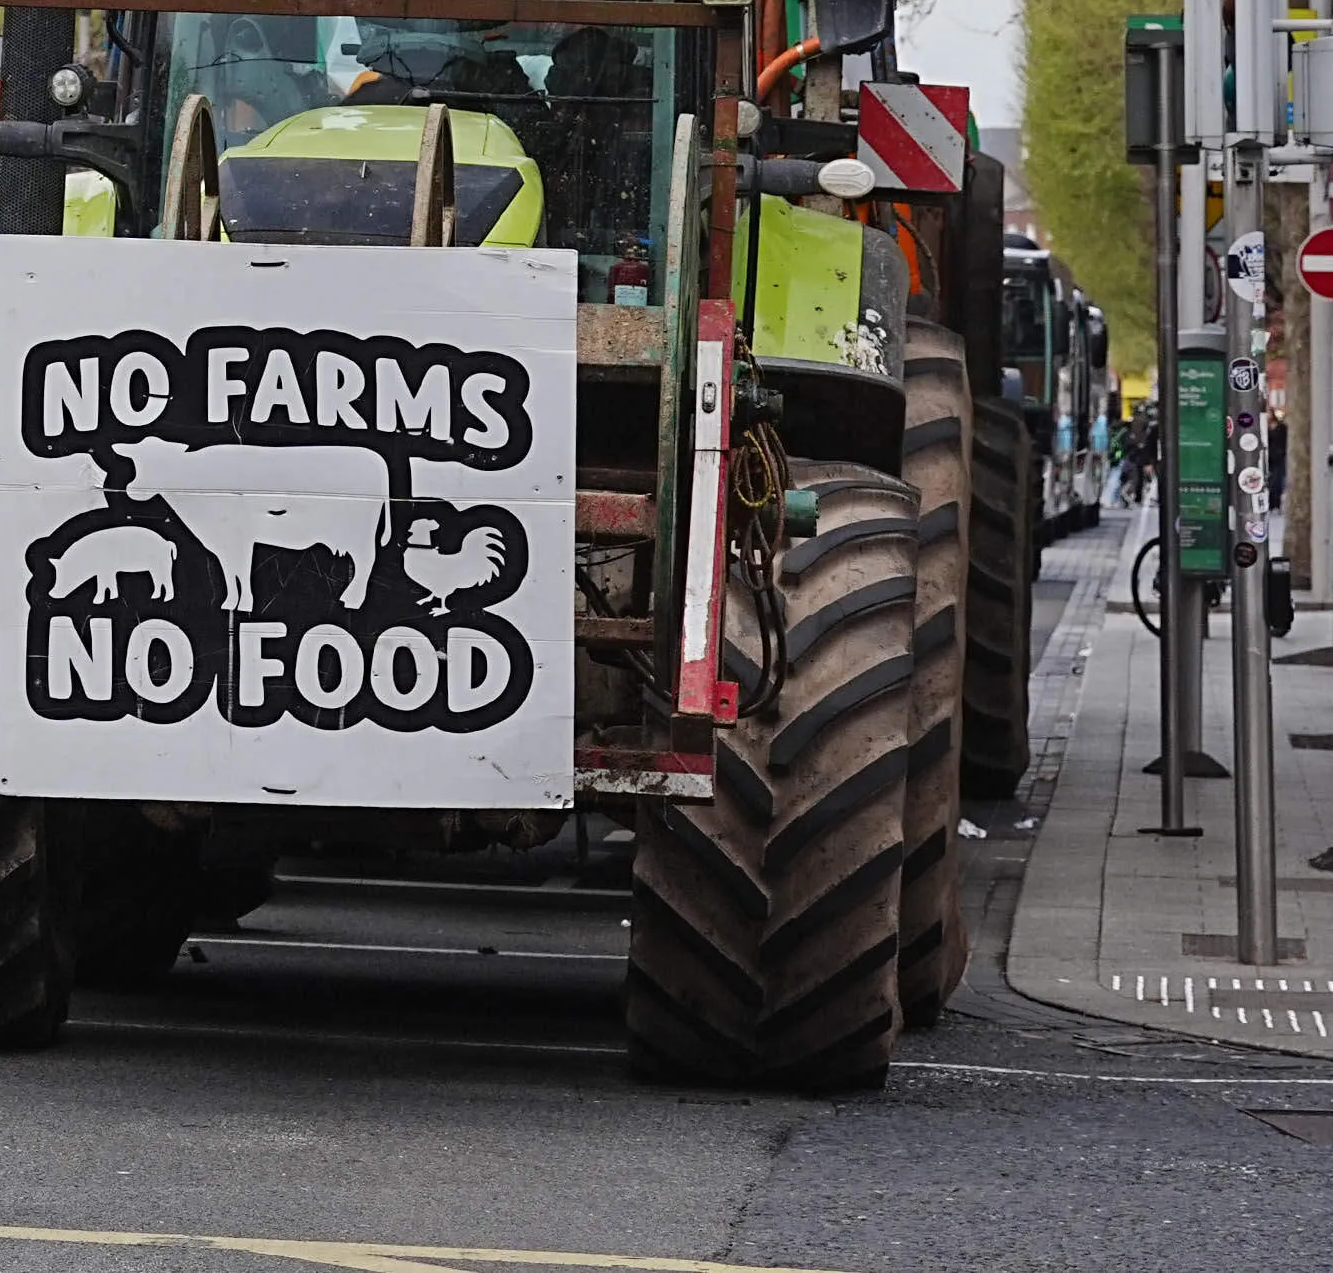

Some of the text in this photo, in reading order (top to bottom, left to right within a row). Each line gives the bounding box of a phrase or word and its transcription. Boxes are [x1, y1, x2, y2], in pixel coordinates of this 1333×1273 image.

[43, 346, 511, 450] NO FARMS
[47, 616, 511, 713] NO FOOD
